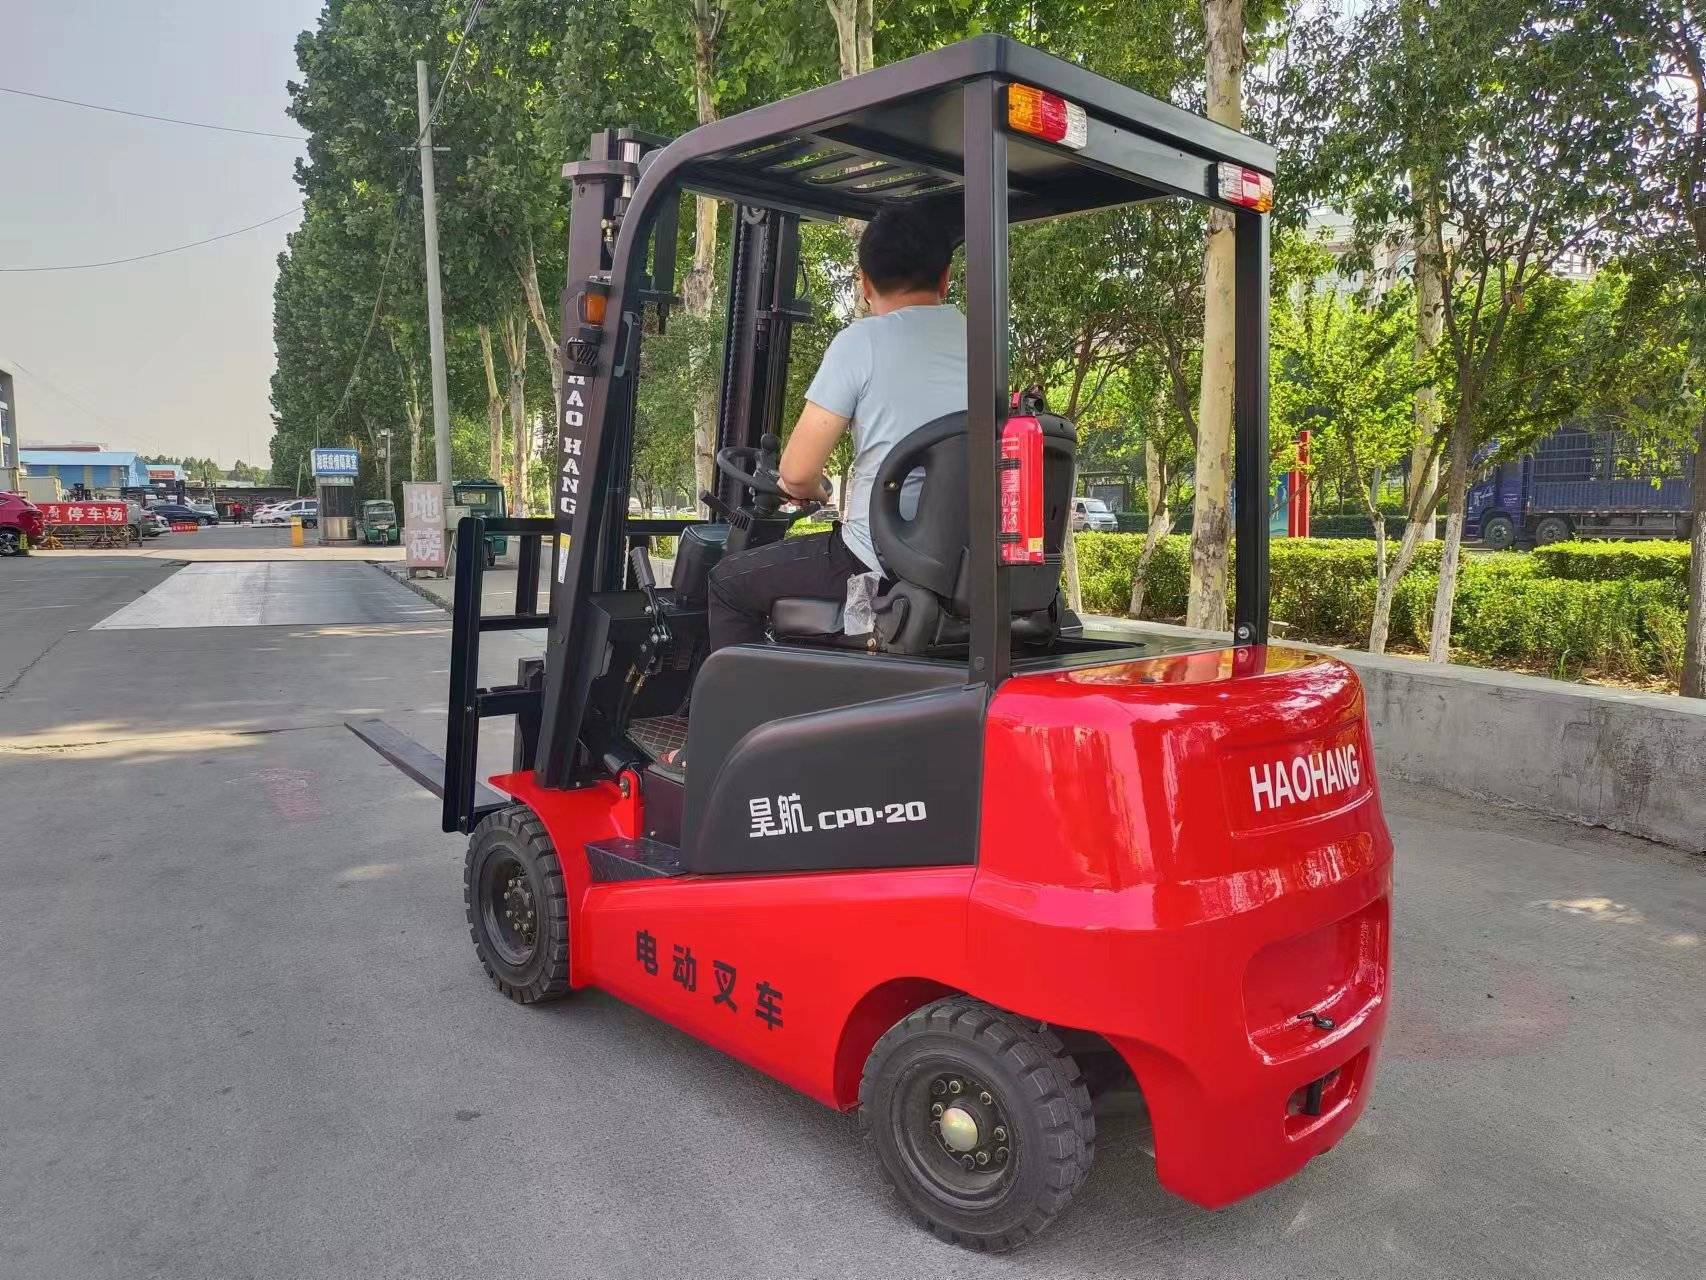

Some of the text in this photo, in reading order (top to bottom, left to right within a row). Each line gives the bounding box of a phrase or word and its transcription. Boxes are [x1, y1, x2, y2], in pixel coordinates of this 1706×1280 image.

[561, 437, 582, 515] HANG
[67, 506, 123, 522] 停车场
[409, 487, 440, 562] 地磅
[1250, 744, 1361, 812] HAOHANG
[636, 930, 783, 1031] 电动叉车
